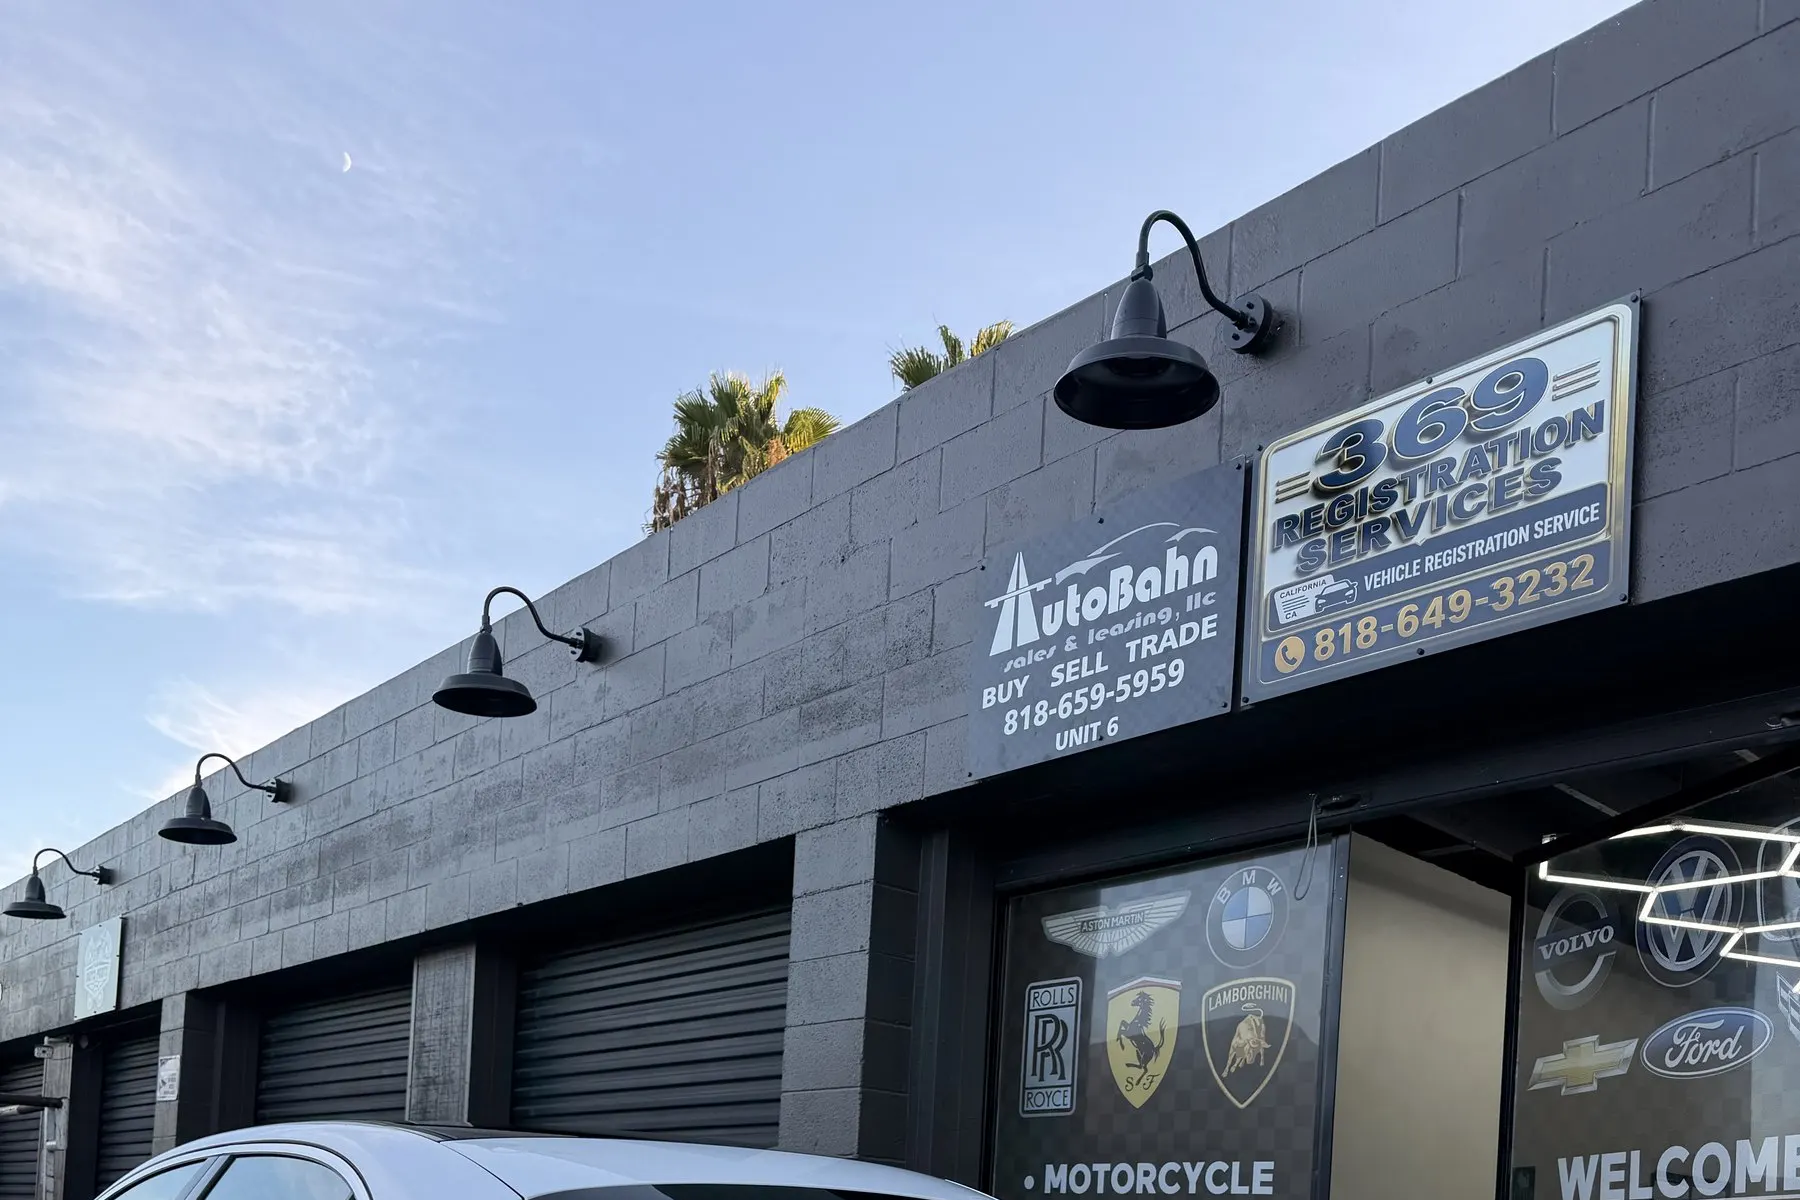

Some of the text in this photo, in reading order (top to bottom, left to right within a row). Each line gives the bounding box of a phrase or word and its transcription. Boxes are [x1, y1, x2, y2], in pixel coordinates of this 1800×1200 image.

[1315, 356, 1550, 489] 369
[1273, 399, 1605, 550] REGISTRATION
[1296, 457, 1562, 573] SERVICES
[1364, 503, 1600, 592] VEHICLE REGISTRATION SERVICE
[1280, 579, 1327, 599] CALIFORNIA
[1285, 611, 1297, 620] CA
[1313, 553, 1595, 661] 818-649-3232
[1004, 646, 1057, 673] sales
[1065, 635, 1077, 651] &
[1186, 592, 1216, 612] llc
[982, 614, 1218, 709] BUY SELL TRADE
[1004, 658, 1185, 735] 818-659-5959
[1055, 716, 1119, 751] UNIT 6
[1217, 870, 1282, 905] BMW
[1081, 912, 1145, 933] ASTON MARTIN
[1538, 925, 1614, 960] VOLVO
[1032, 987, 1075, 1008] ROLLS
[1208, 984, 1288, 1012] LAMBORGHINI
[1664, 1019, 1745, 1069] Ford
[1026, 1089, 1068, 1108] ROYCE
[1044, 1161, 1275, 1195] MOTORCYCLE
